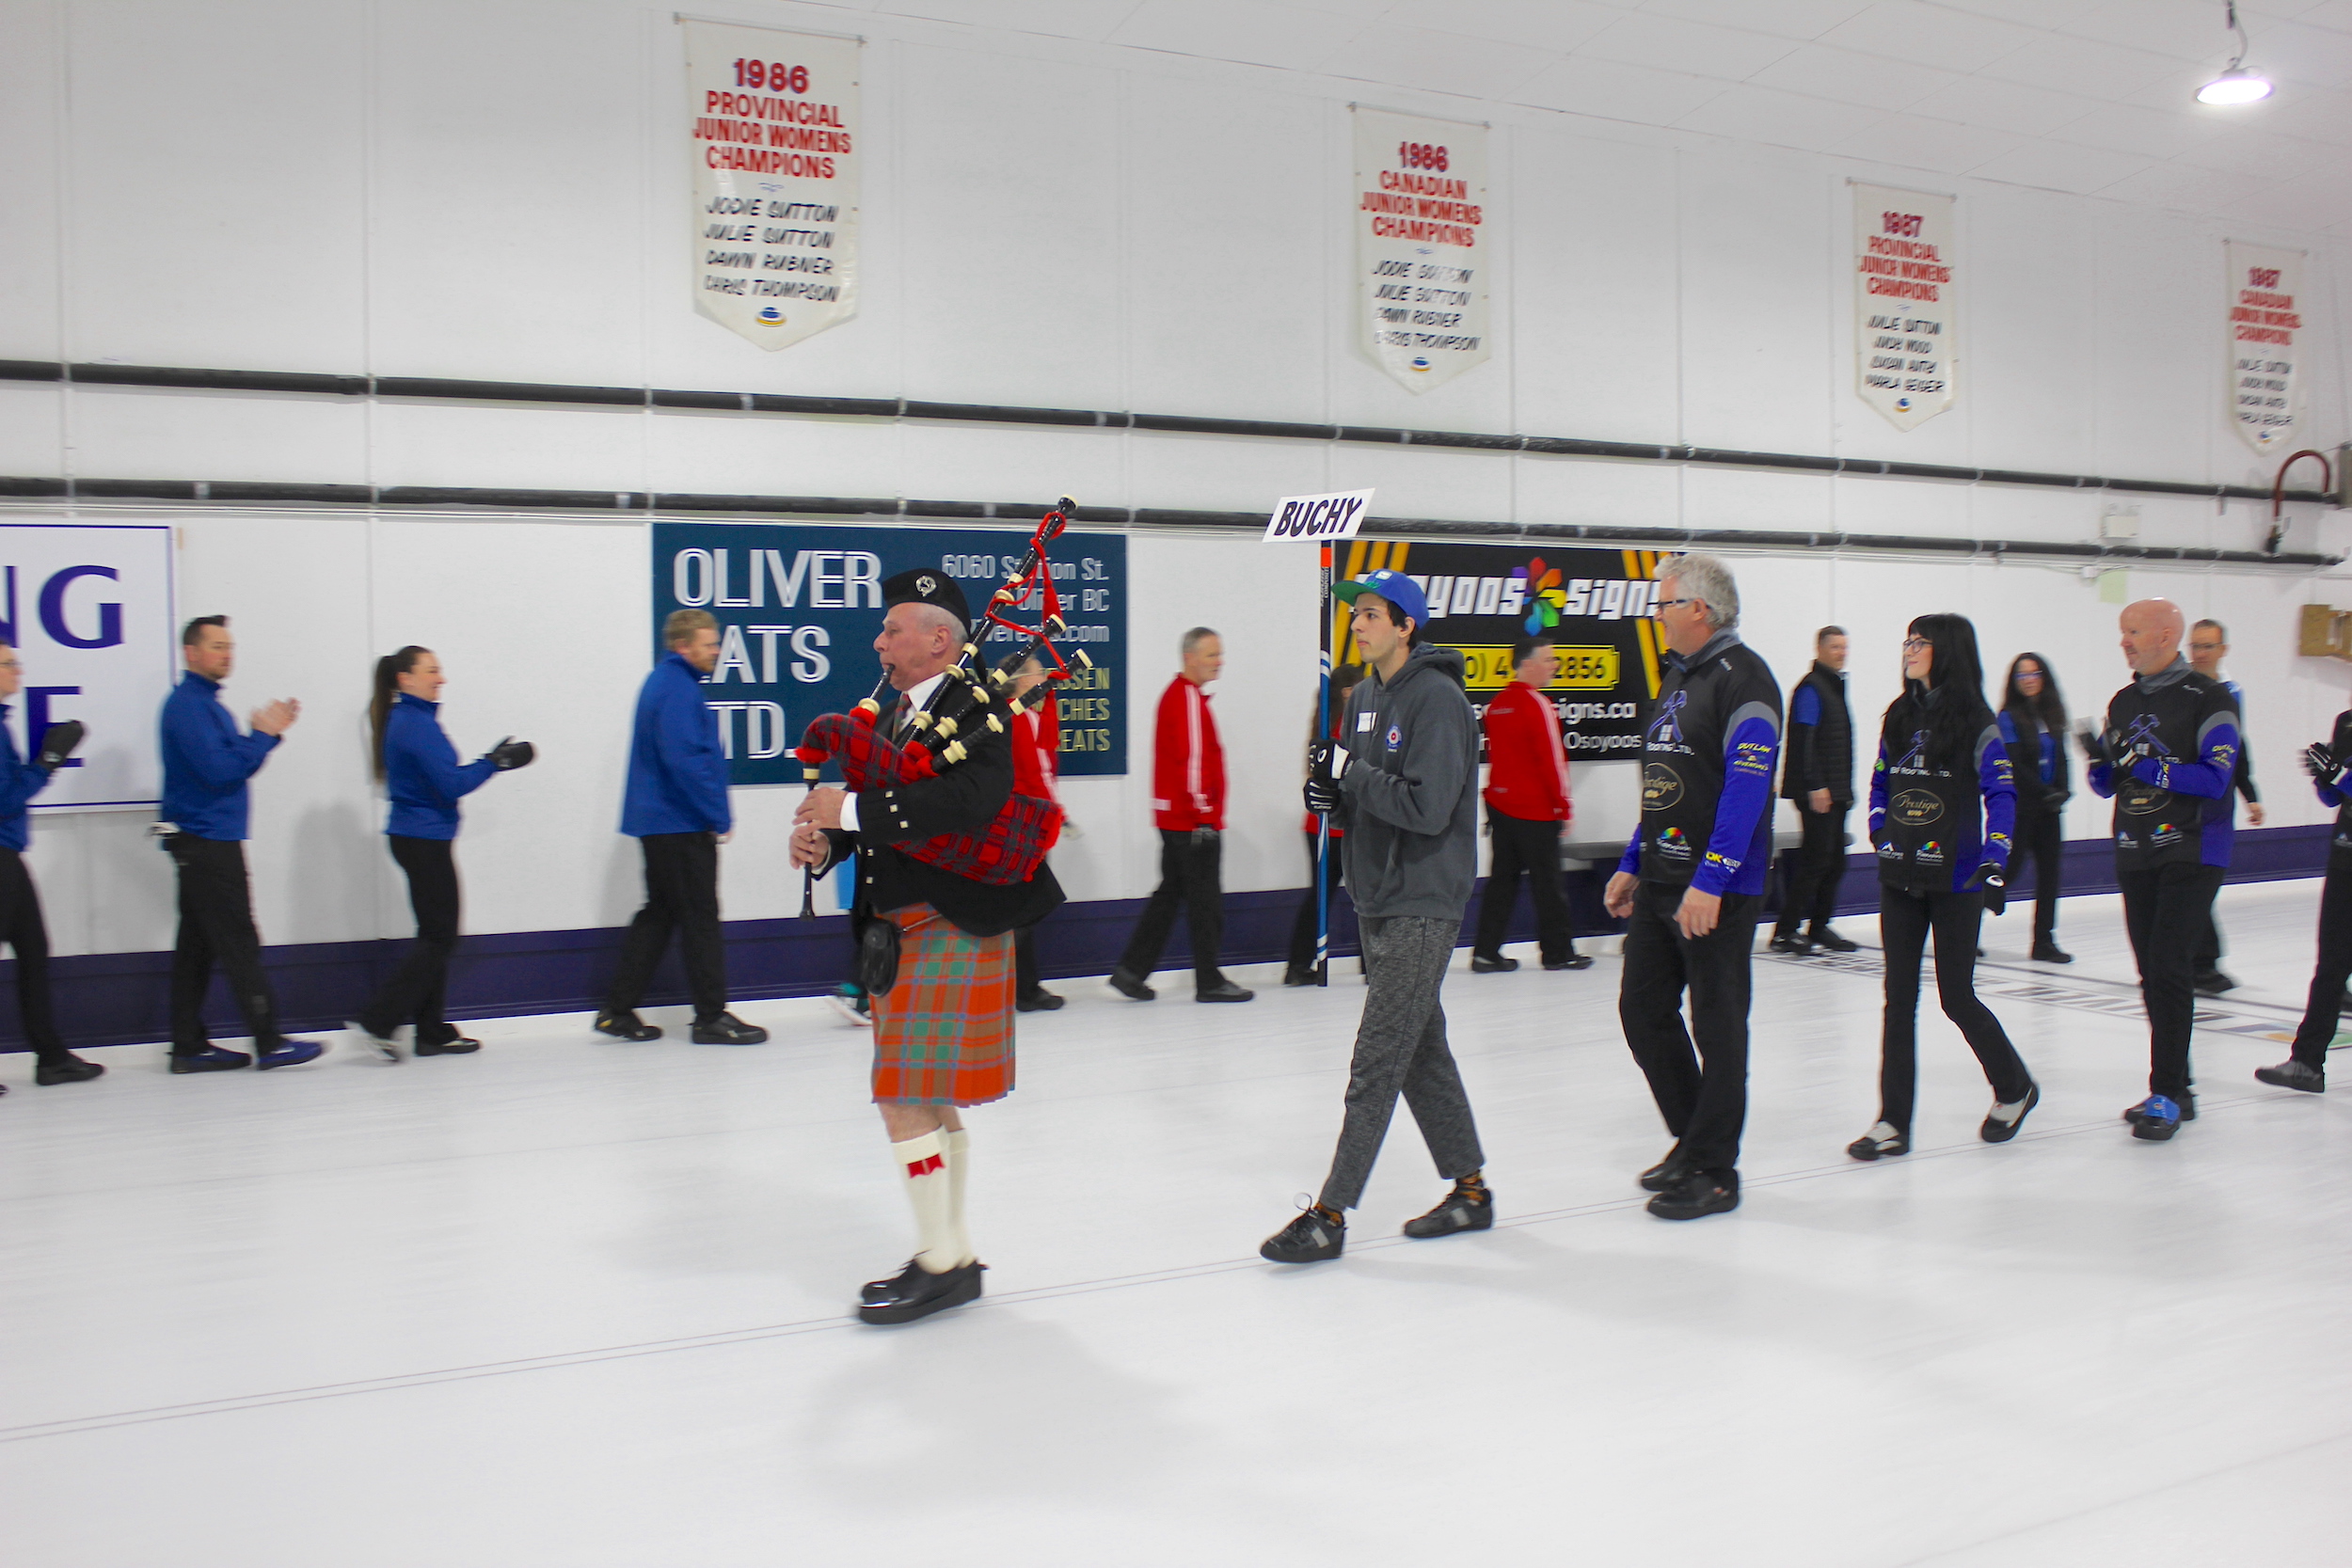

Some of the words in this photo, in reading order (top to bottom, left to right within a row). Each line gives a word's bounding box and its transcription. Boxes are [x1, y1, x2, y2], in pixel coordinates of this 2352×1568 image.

[734, 57, 809, 94] 1986
[706, 90, 845, 128] PROVINCIAL
[692, 117, 763, 145] JUNIOR
[769, 124, 852, 154] WOMENS
[706, 145, 836, 179] CHAMPIONS
[1398, 141, 1450, 172] 1986
[1378, 169, 1468, 200] CANADIAN
[705, 196, 762, 217] JODIE
[767, 202, 839, 223] SUTTON
[1359, 191, 1415, 216] JUNIOR
[1418, 198, 1483, 225] WOMENS
[703, 223, 757, 242] JULIE
[762, 229, 835, 249] SUTTON
[1371, 216, 1474, 247] CHAMPIONS
[1881, 211, 1925, 237] 1987
[705, 249, 756, 269] DAWN
[1867, 235, 1942, 263] PROVINCIAL
[1371, 260, 1414, 278] JODIE
[1858, 255, 1899, 277] JUNIOR
[1900, 261, 1951, 284] WOMENS
[704, 275, 748, 296] CHRIS
[751, 279, 840, 303] THOMPSON
[1374, 284, 1413, 301] JULIE
[1866, 277, 1940, 303] CHAMPIONS
[1274, 497, 1362, 538] BUCHY
[674, 547, 883, 609] OLIVER
[942, 554, 995, 579] 6060
[1016, 587, 1077, 611] Olier
[1082, 589, 1110, 611] BC
[699, 625, 831, 684] ATS
[704, 701, 797, 760] TD.
[1564, 732, 1643, 752] Osoyoos
